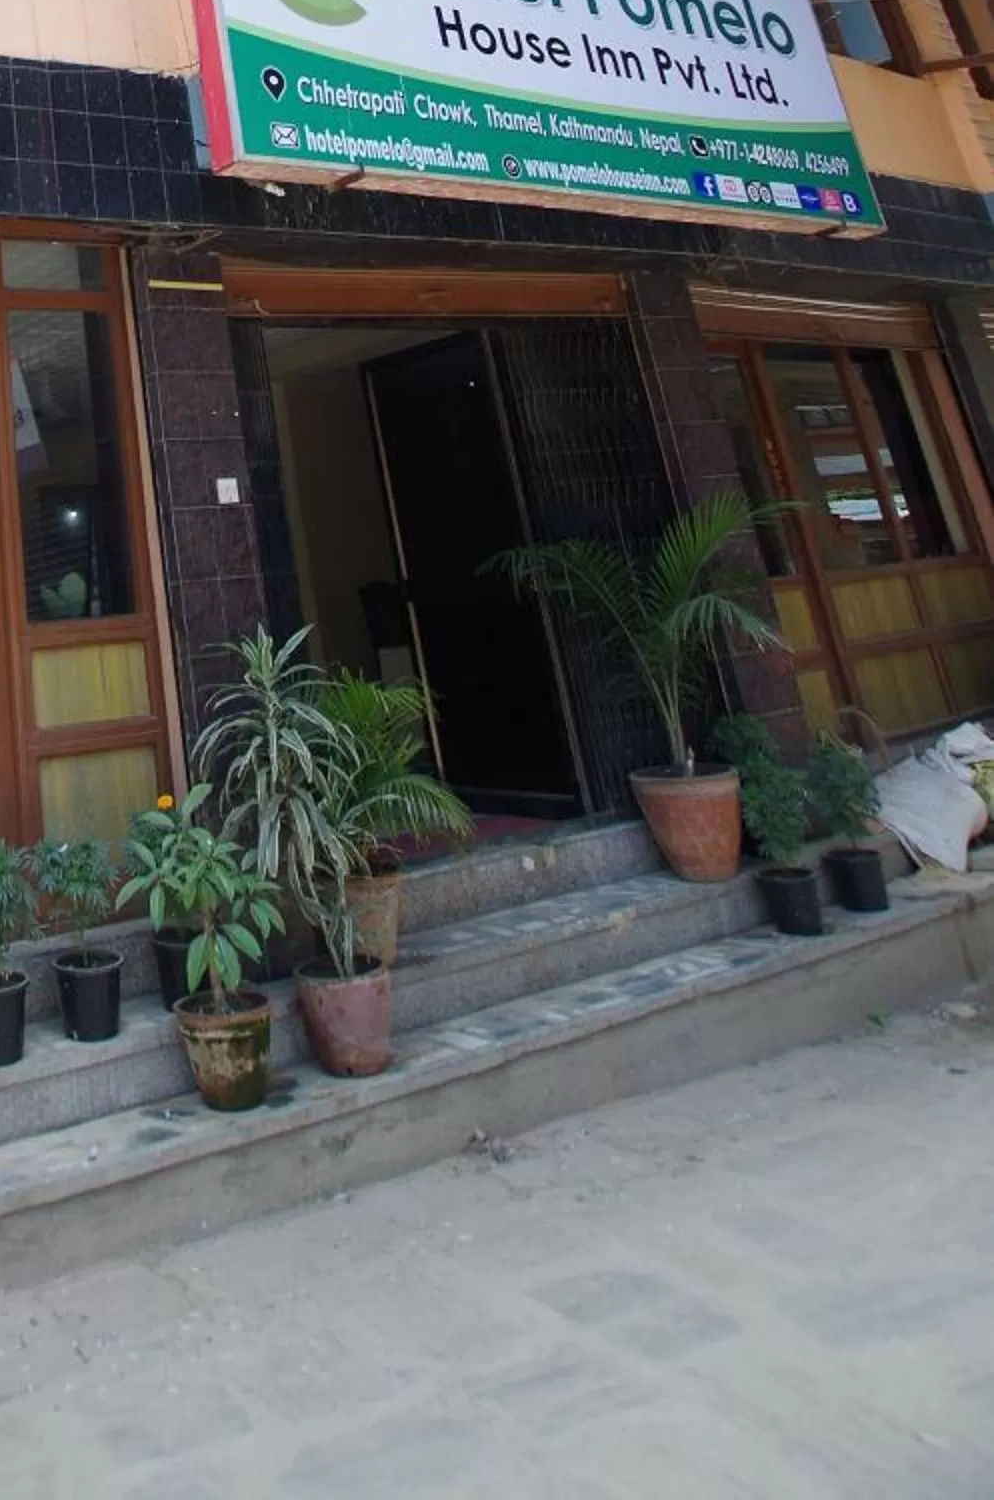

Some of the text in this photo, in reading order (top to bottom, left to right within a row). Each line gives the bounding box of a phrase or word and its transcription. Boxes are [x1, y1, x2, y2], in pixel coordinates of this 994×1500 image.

[434, 5, 790, 108] House Inn Pvt. Ltd.
[297, 75, 406, 118] Chhetrapati
[413, 93, 478, 128] Chowk,
[483, 103, 548, 138] Thamel,
[304, 123, 491, 173] hotelpomelo@gmail.com
